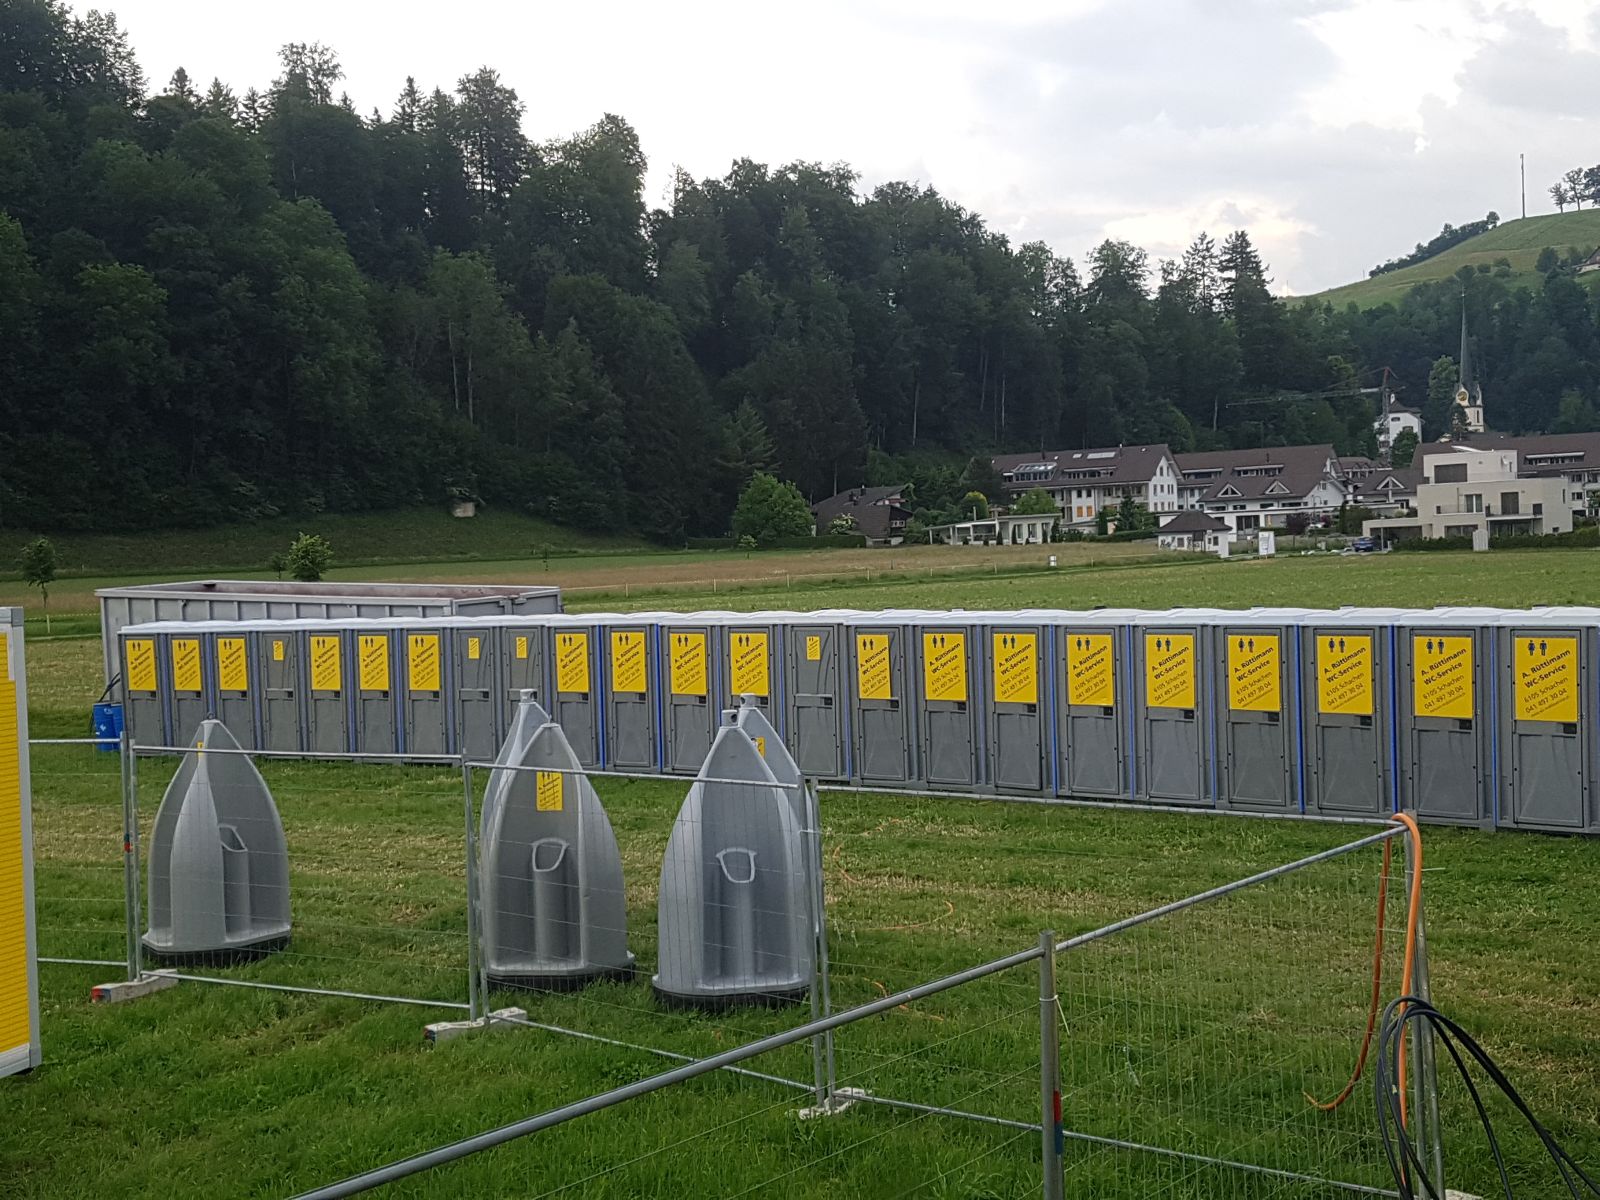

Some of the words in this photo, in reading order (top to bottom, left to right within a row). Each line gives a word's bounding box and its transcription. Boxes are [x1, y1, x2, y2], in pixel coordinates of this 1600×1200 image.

[1236, 660, 1270, 682] WC-Service
[1327, 661, 1363, 683] WC-Service
[1424, 662, 1462, 685] WC-Service
[1525, 664, 1566, 688] WC-Service
